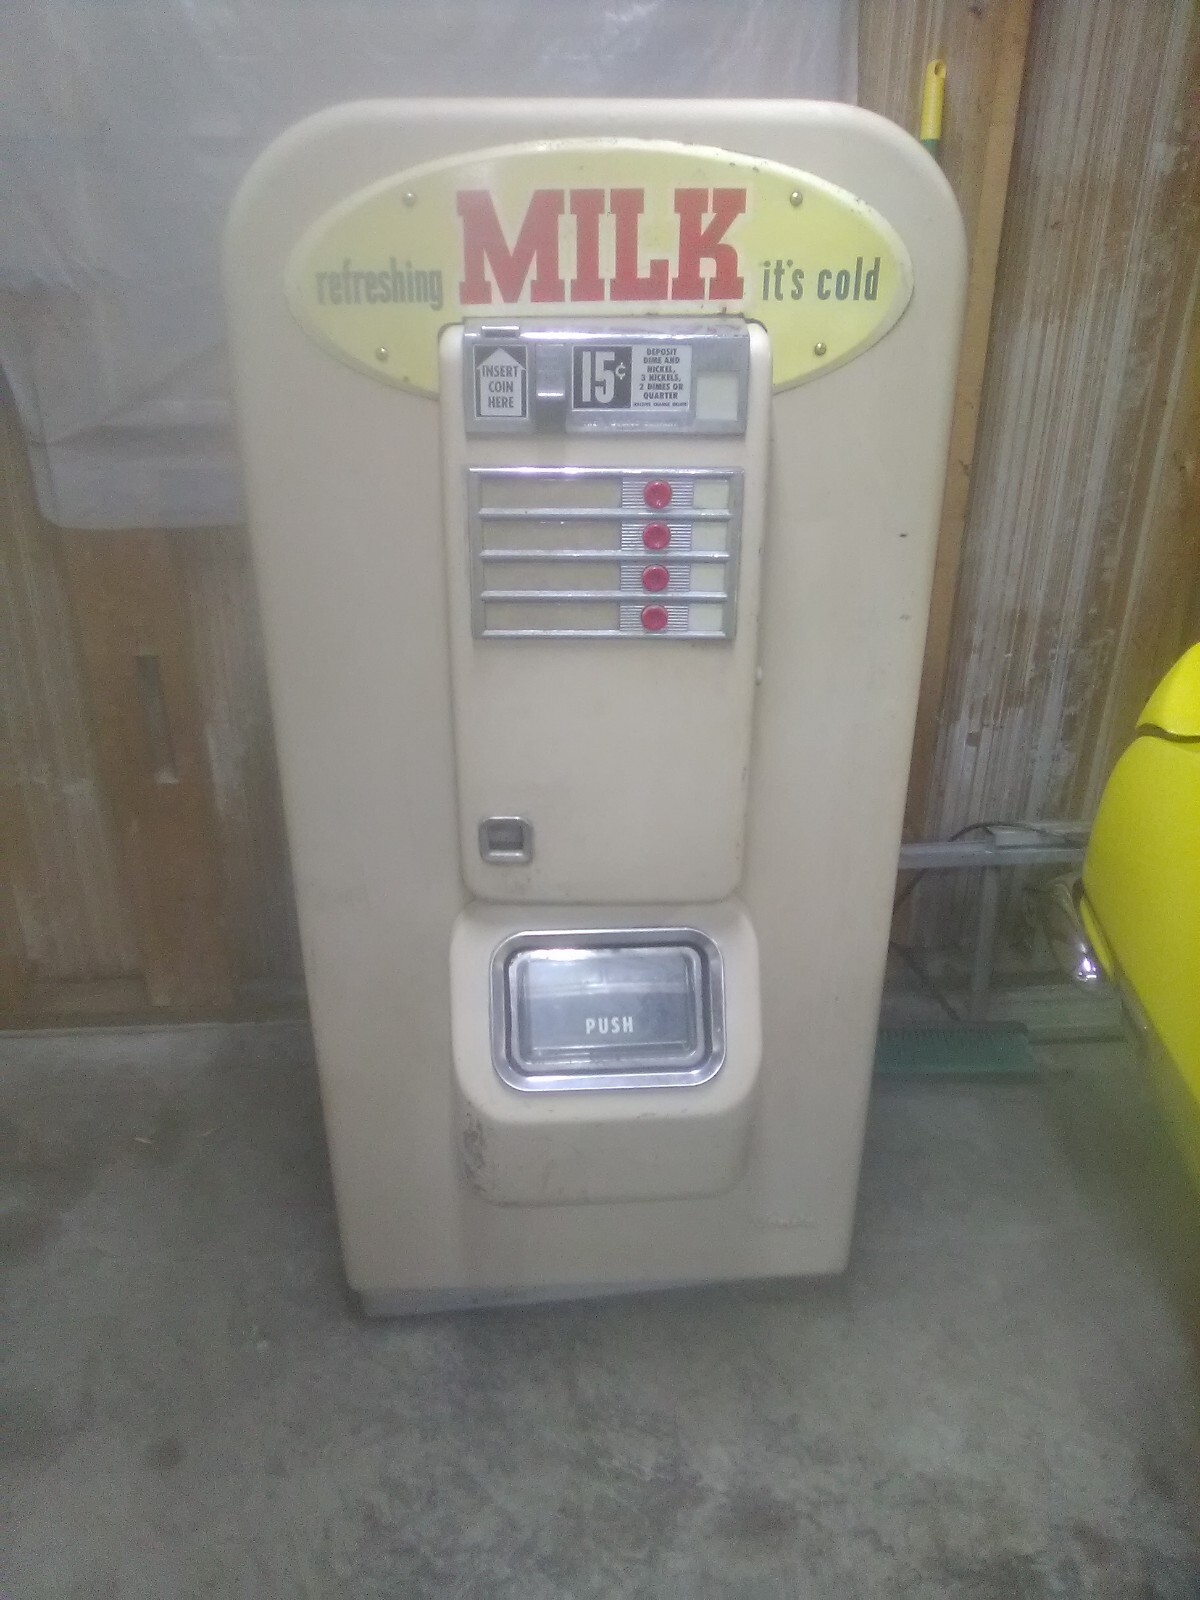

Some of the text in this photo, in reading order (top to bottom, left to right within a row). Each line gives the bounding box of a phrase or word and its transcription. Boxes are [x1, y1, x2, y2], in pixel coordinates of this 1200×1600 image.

[457, 188, 747, 304] MILK
[315, 258, 444, 311] refreshing
[762, 256, 881, 301] it's cold
[646, 348, 677, 356] DEPOSIT
[482, 365, 518, 378] INSERT
[649, 374, 681, 382] NICKELS,
[488, 381, 514, 393] COIN
[647, 383, 671, 391] DIMES
[672, 383, 683, 391] OR
[488, 396, 514, 409] HERE
[643, 392, 679, 400] QUARTER
[586, 1016, 633, 1034] PUSH
